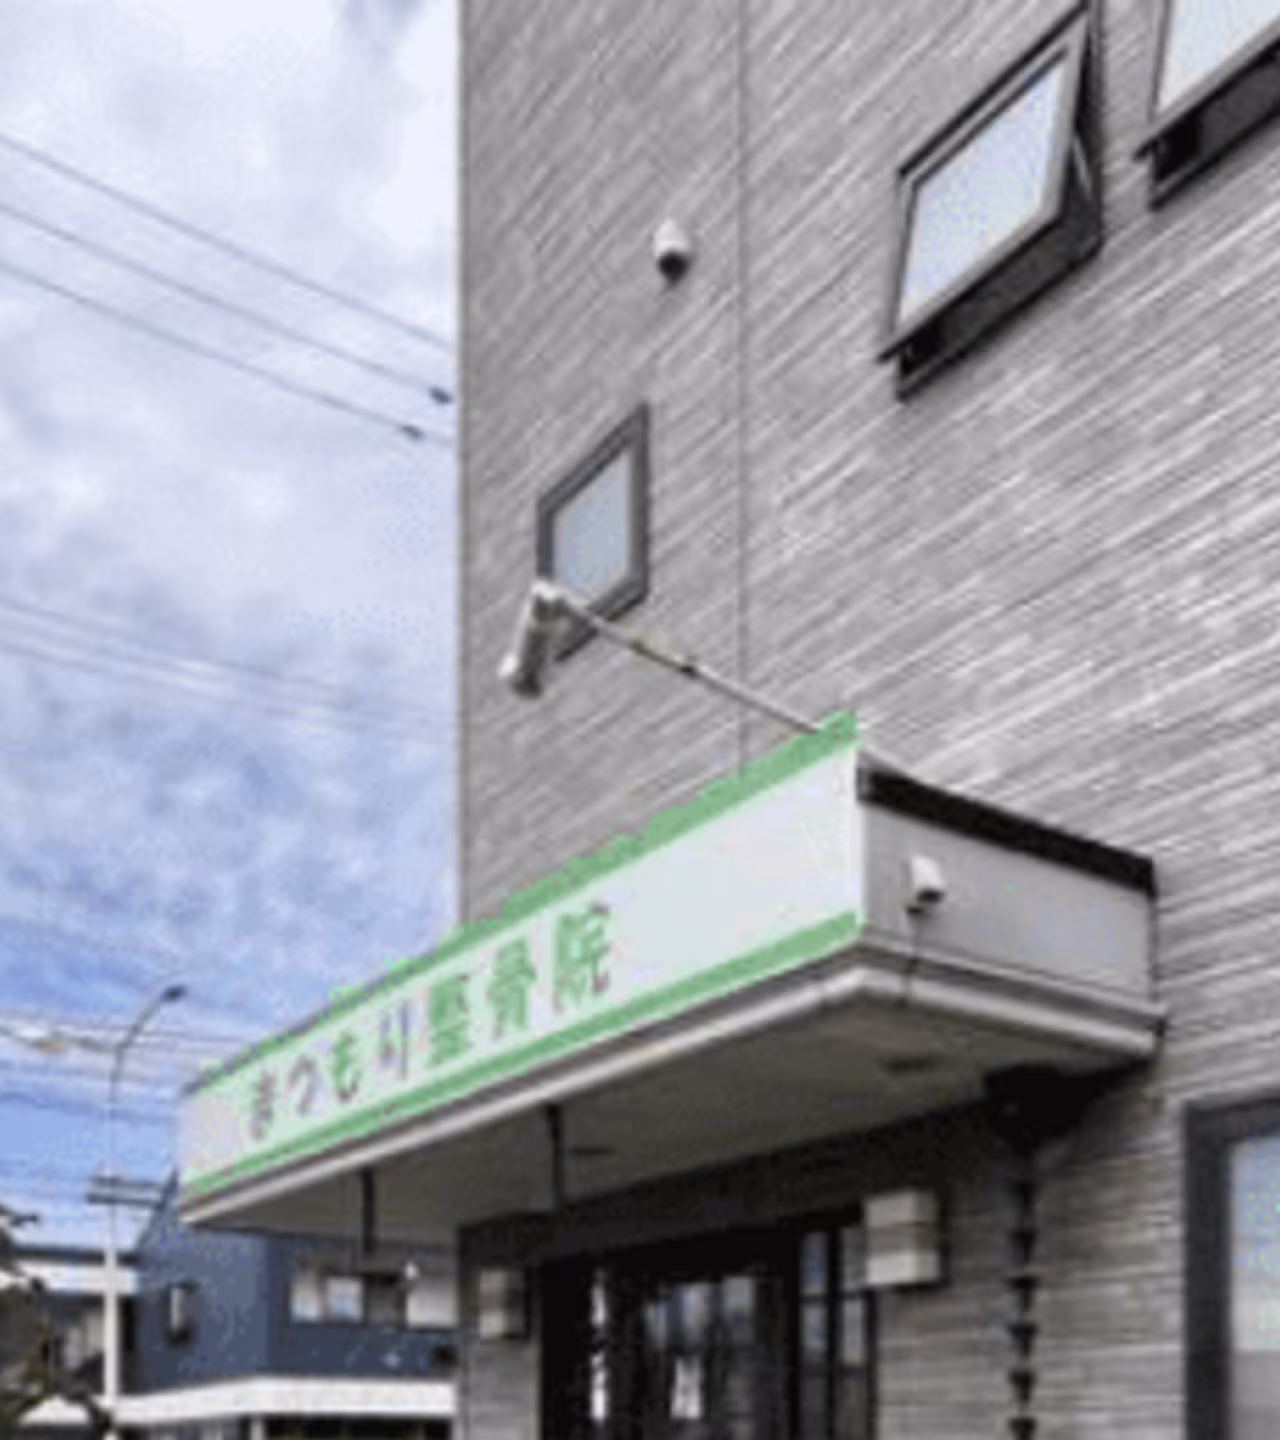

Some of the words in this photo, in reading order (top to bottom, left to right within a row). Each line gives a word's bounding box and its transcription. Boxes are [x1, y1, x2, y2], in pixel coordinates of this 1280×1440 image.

[248, 902, 613, 1141] まつもり整骨院
